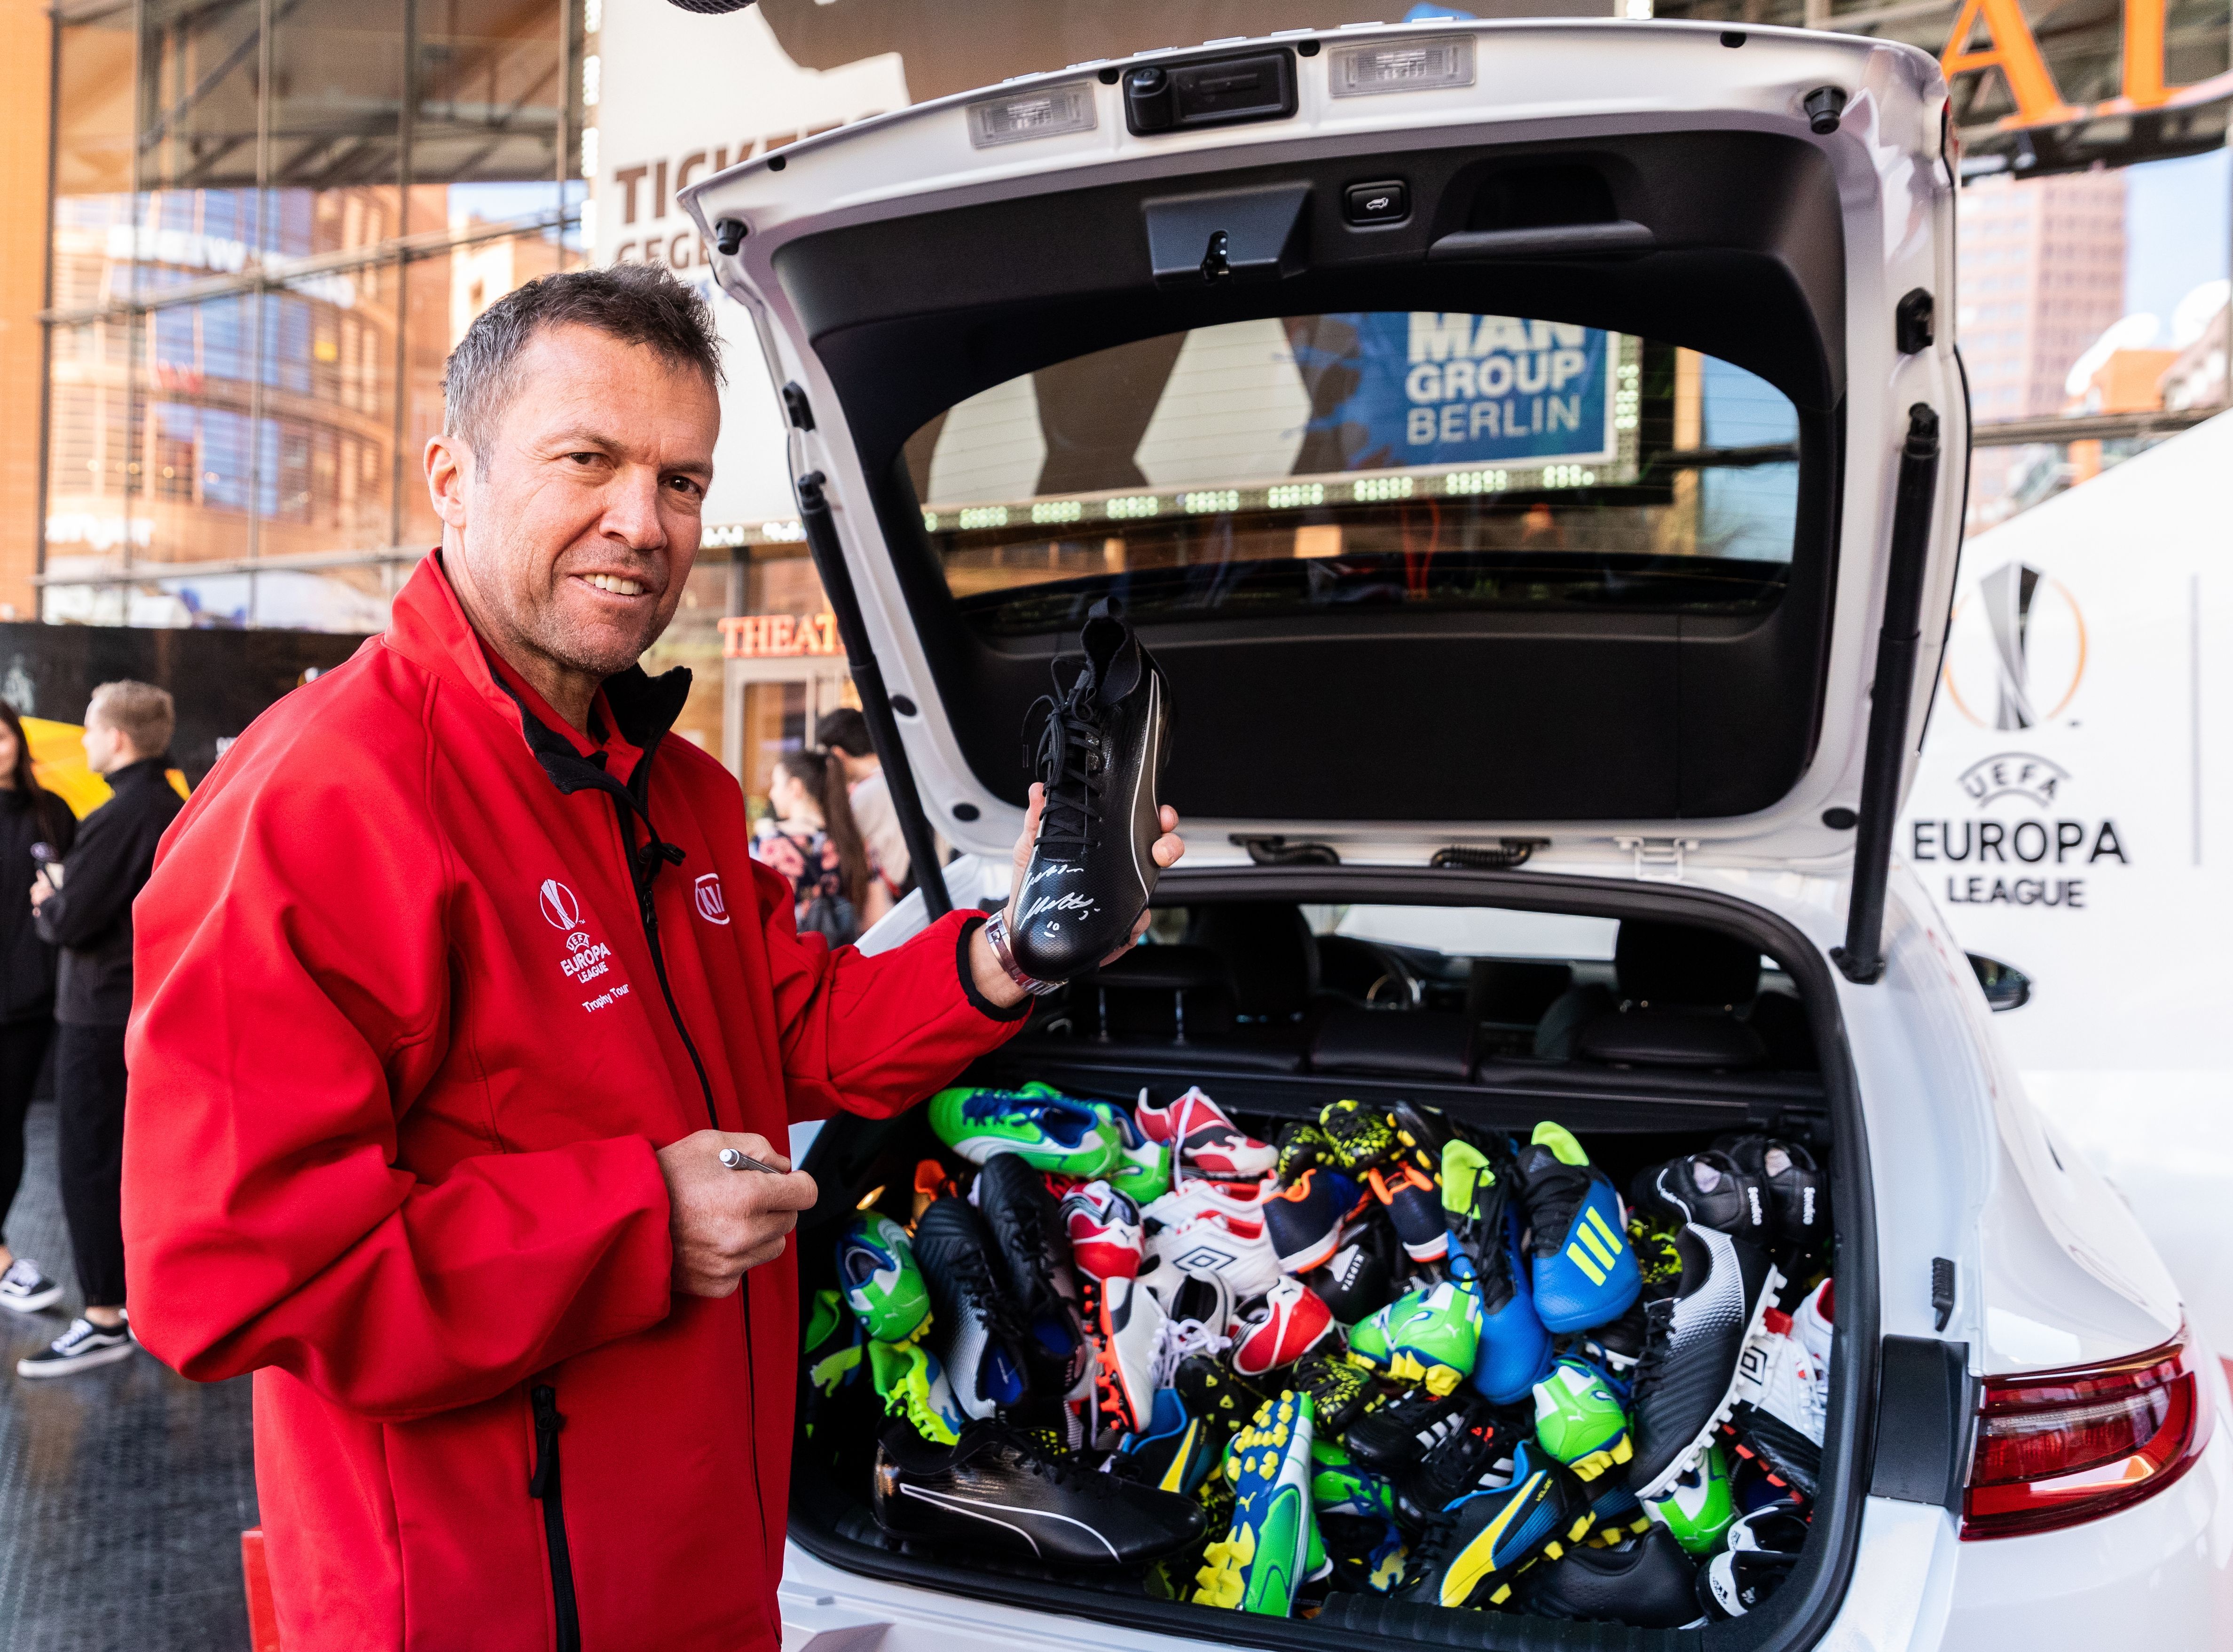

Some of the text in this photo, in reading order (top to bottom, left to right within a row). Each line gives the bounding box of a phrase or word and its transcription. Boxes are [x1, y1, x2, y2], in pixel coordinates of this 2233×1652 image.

[1405, 350, 1586, 404] GROUP
[1407, 394, 1581, 445] BERLIN
[717, 613, 846, 658] THEAT
[1965, 761, 2059, 802] UEFA
[1913, 820, 2129, 865] EUROPA
[1947, 877, 2086, 908] LEAGUE
[560, 942, 611, 977] EUROPA
[567, 934, 590, 950] UEFA
[577, 961, 609, 984] LEAGUE
[582, 984, 629, 1013] Trophy Tour
[1341, 1253, 1365, 1292] KIPSTA
